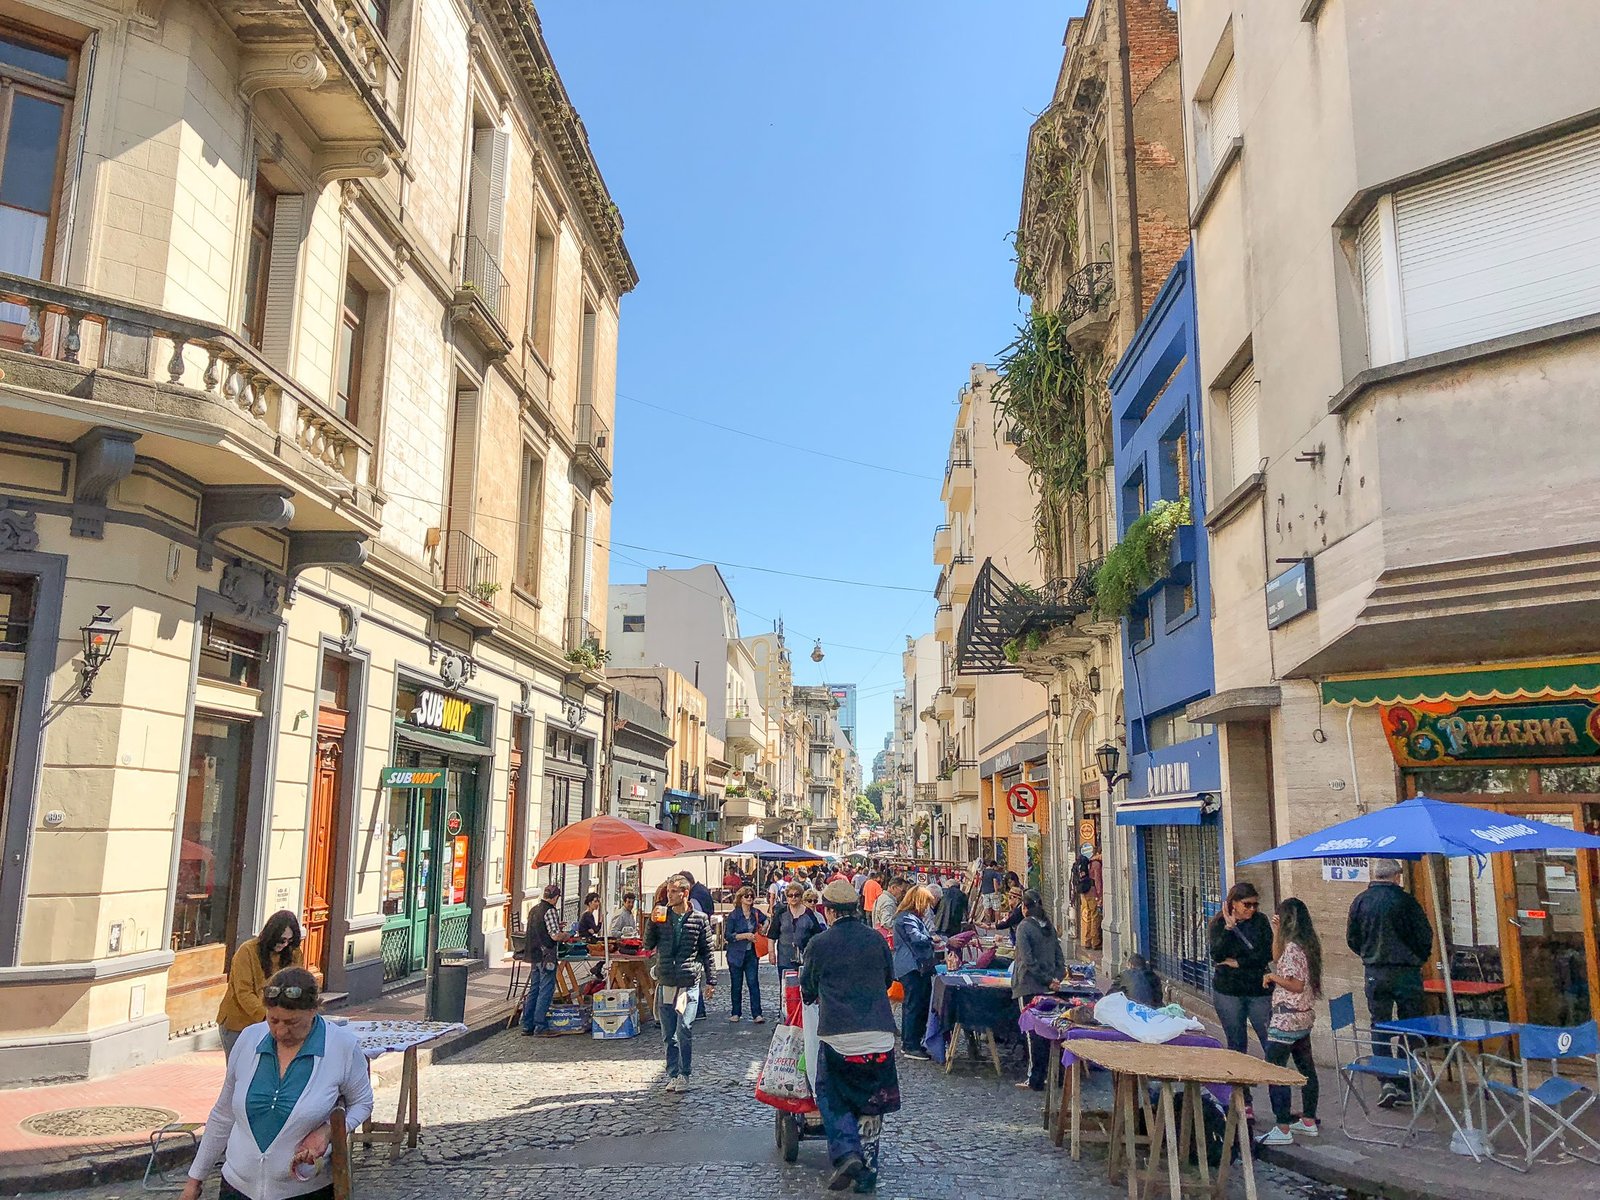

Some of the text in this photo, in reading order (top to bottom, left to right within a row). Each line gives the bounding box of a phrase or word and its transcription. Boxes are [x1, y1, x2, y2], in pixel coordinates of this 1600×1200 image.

[411, 689, 472, 733] SUBWAY
[1437, 714, 1579, 755] PIZZERIA
[386, 772, 442, 785] SUBWAY
[1147, 761, 1191, 794] QUORUM
[1470, 823, 1539, 845] Quilmes
